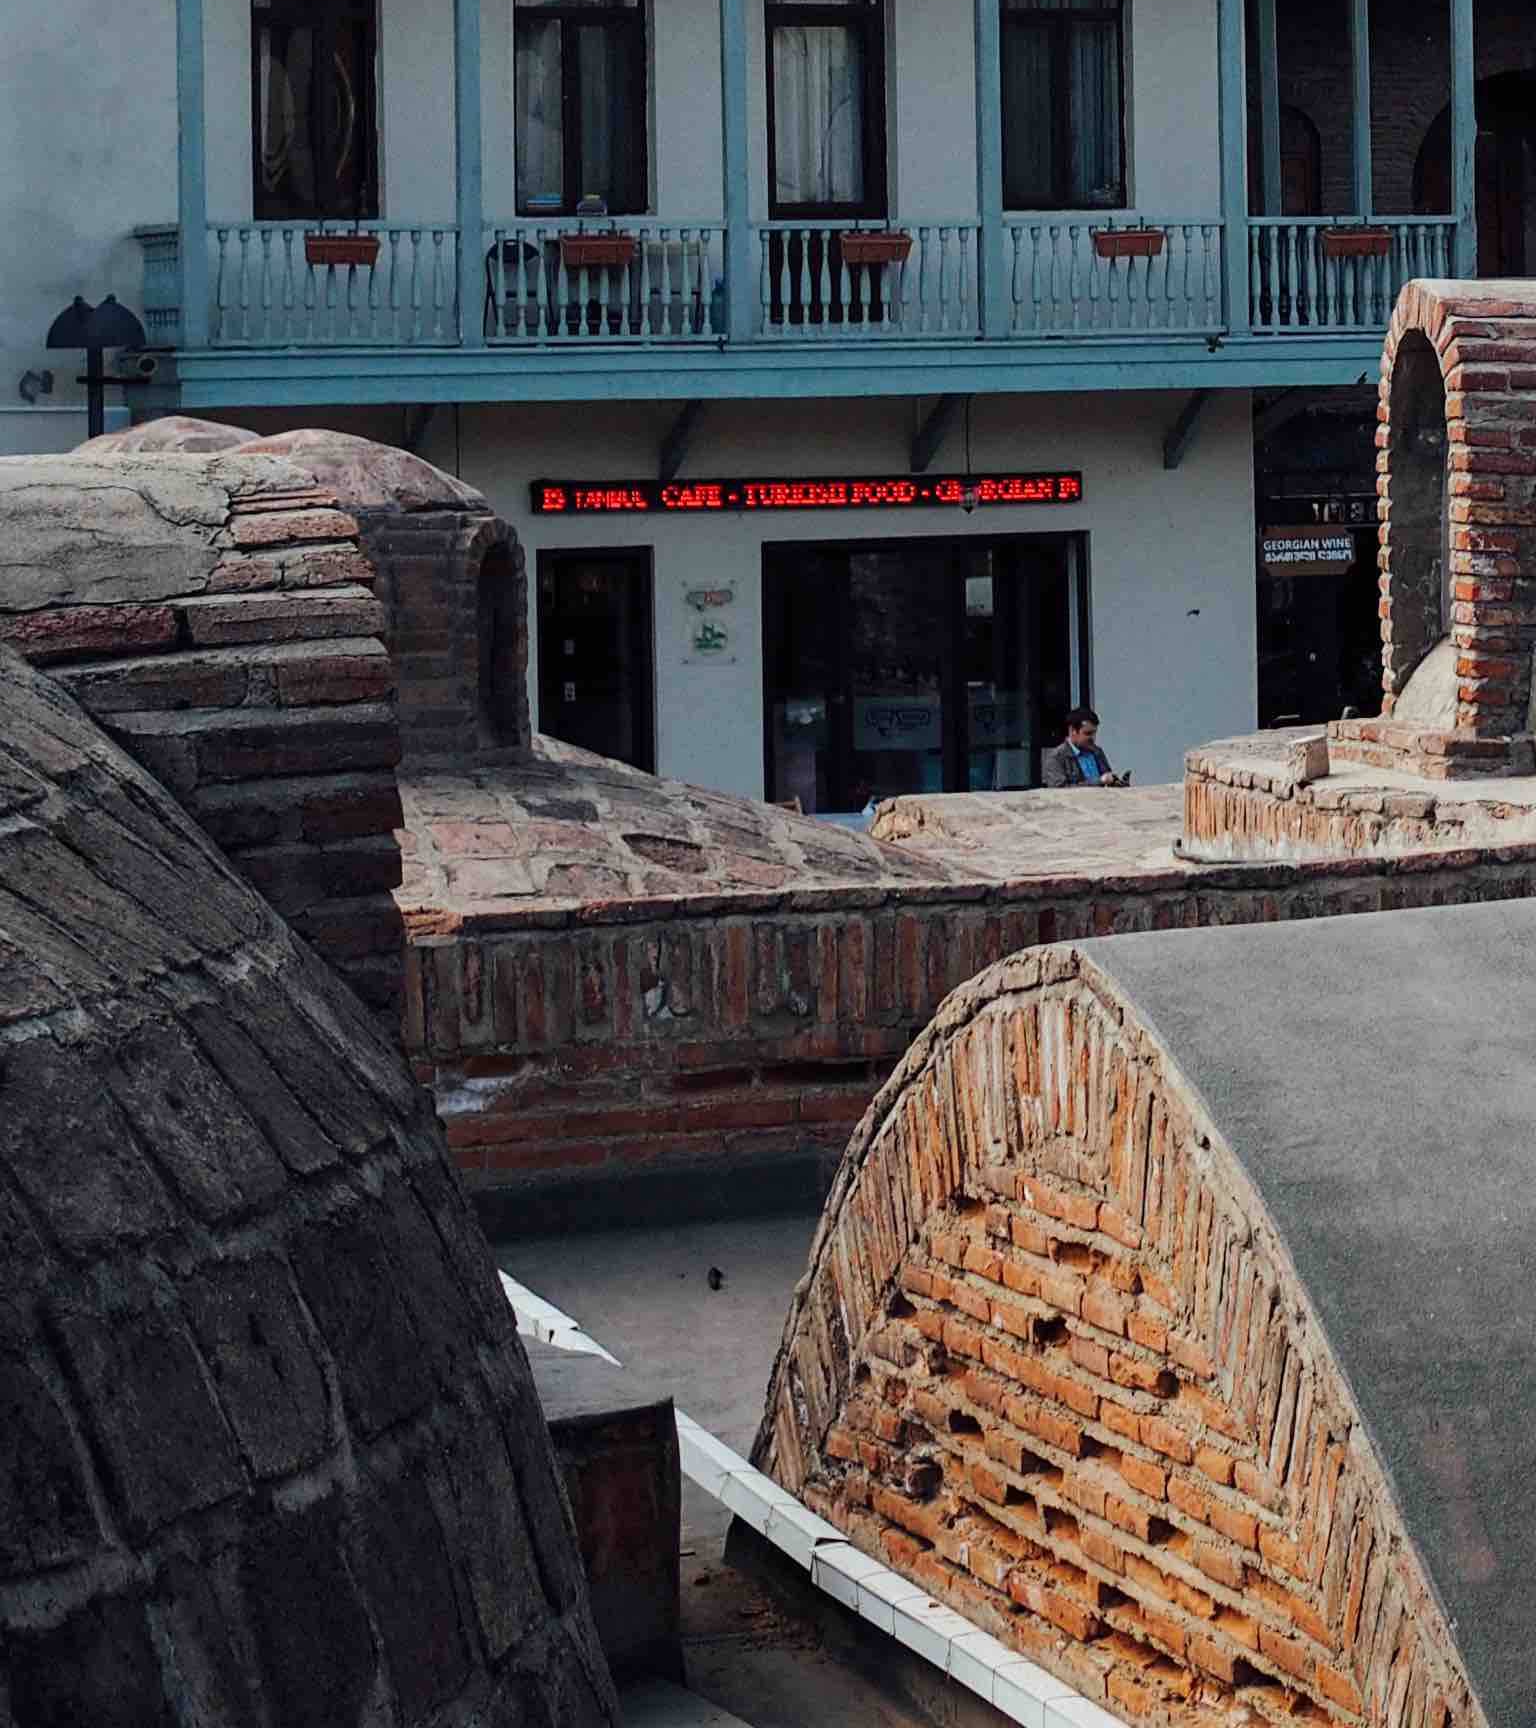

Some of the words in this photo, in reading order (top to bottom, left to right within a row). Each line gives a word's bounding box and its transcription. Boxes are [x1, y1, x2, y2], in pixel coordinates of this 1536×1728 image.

[661, 482, 723, 509] CAFE
[744, 481, 849, 508] TURKISH
[851, 479, 917, 505] FOOD
[1263, 539, 1319, 551] GEORGIAN
[1321, 537, 1352, 549] WINE
